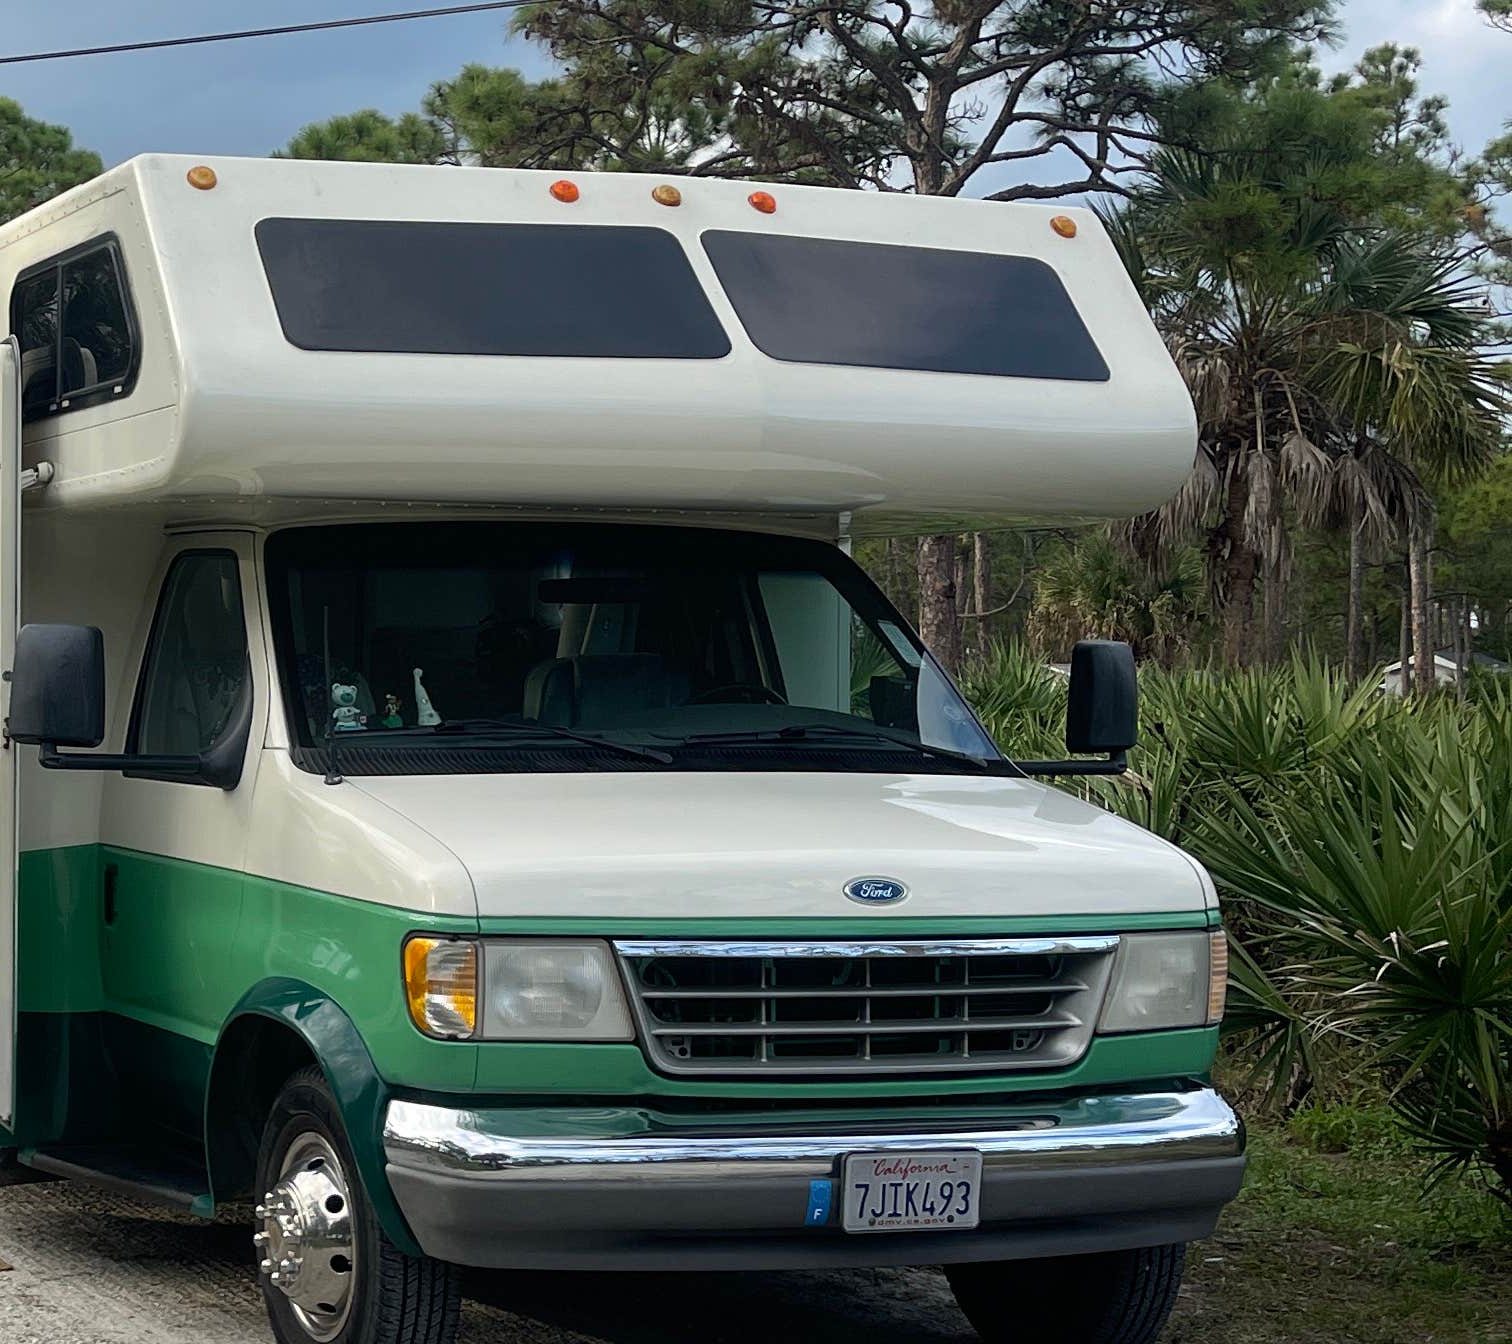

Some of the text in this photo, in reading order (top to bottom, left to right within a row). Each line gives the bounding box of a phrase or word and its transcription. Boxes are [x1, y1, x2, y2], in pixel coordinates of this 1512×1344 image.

[860, 882, 893, 898] Ford
[873, 1158, 957, 1180] California
[854, 1180, 971, 1219] 7JIK493
[813, 1208, 823, 1221] F
